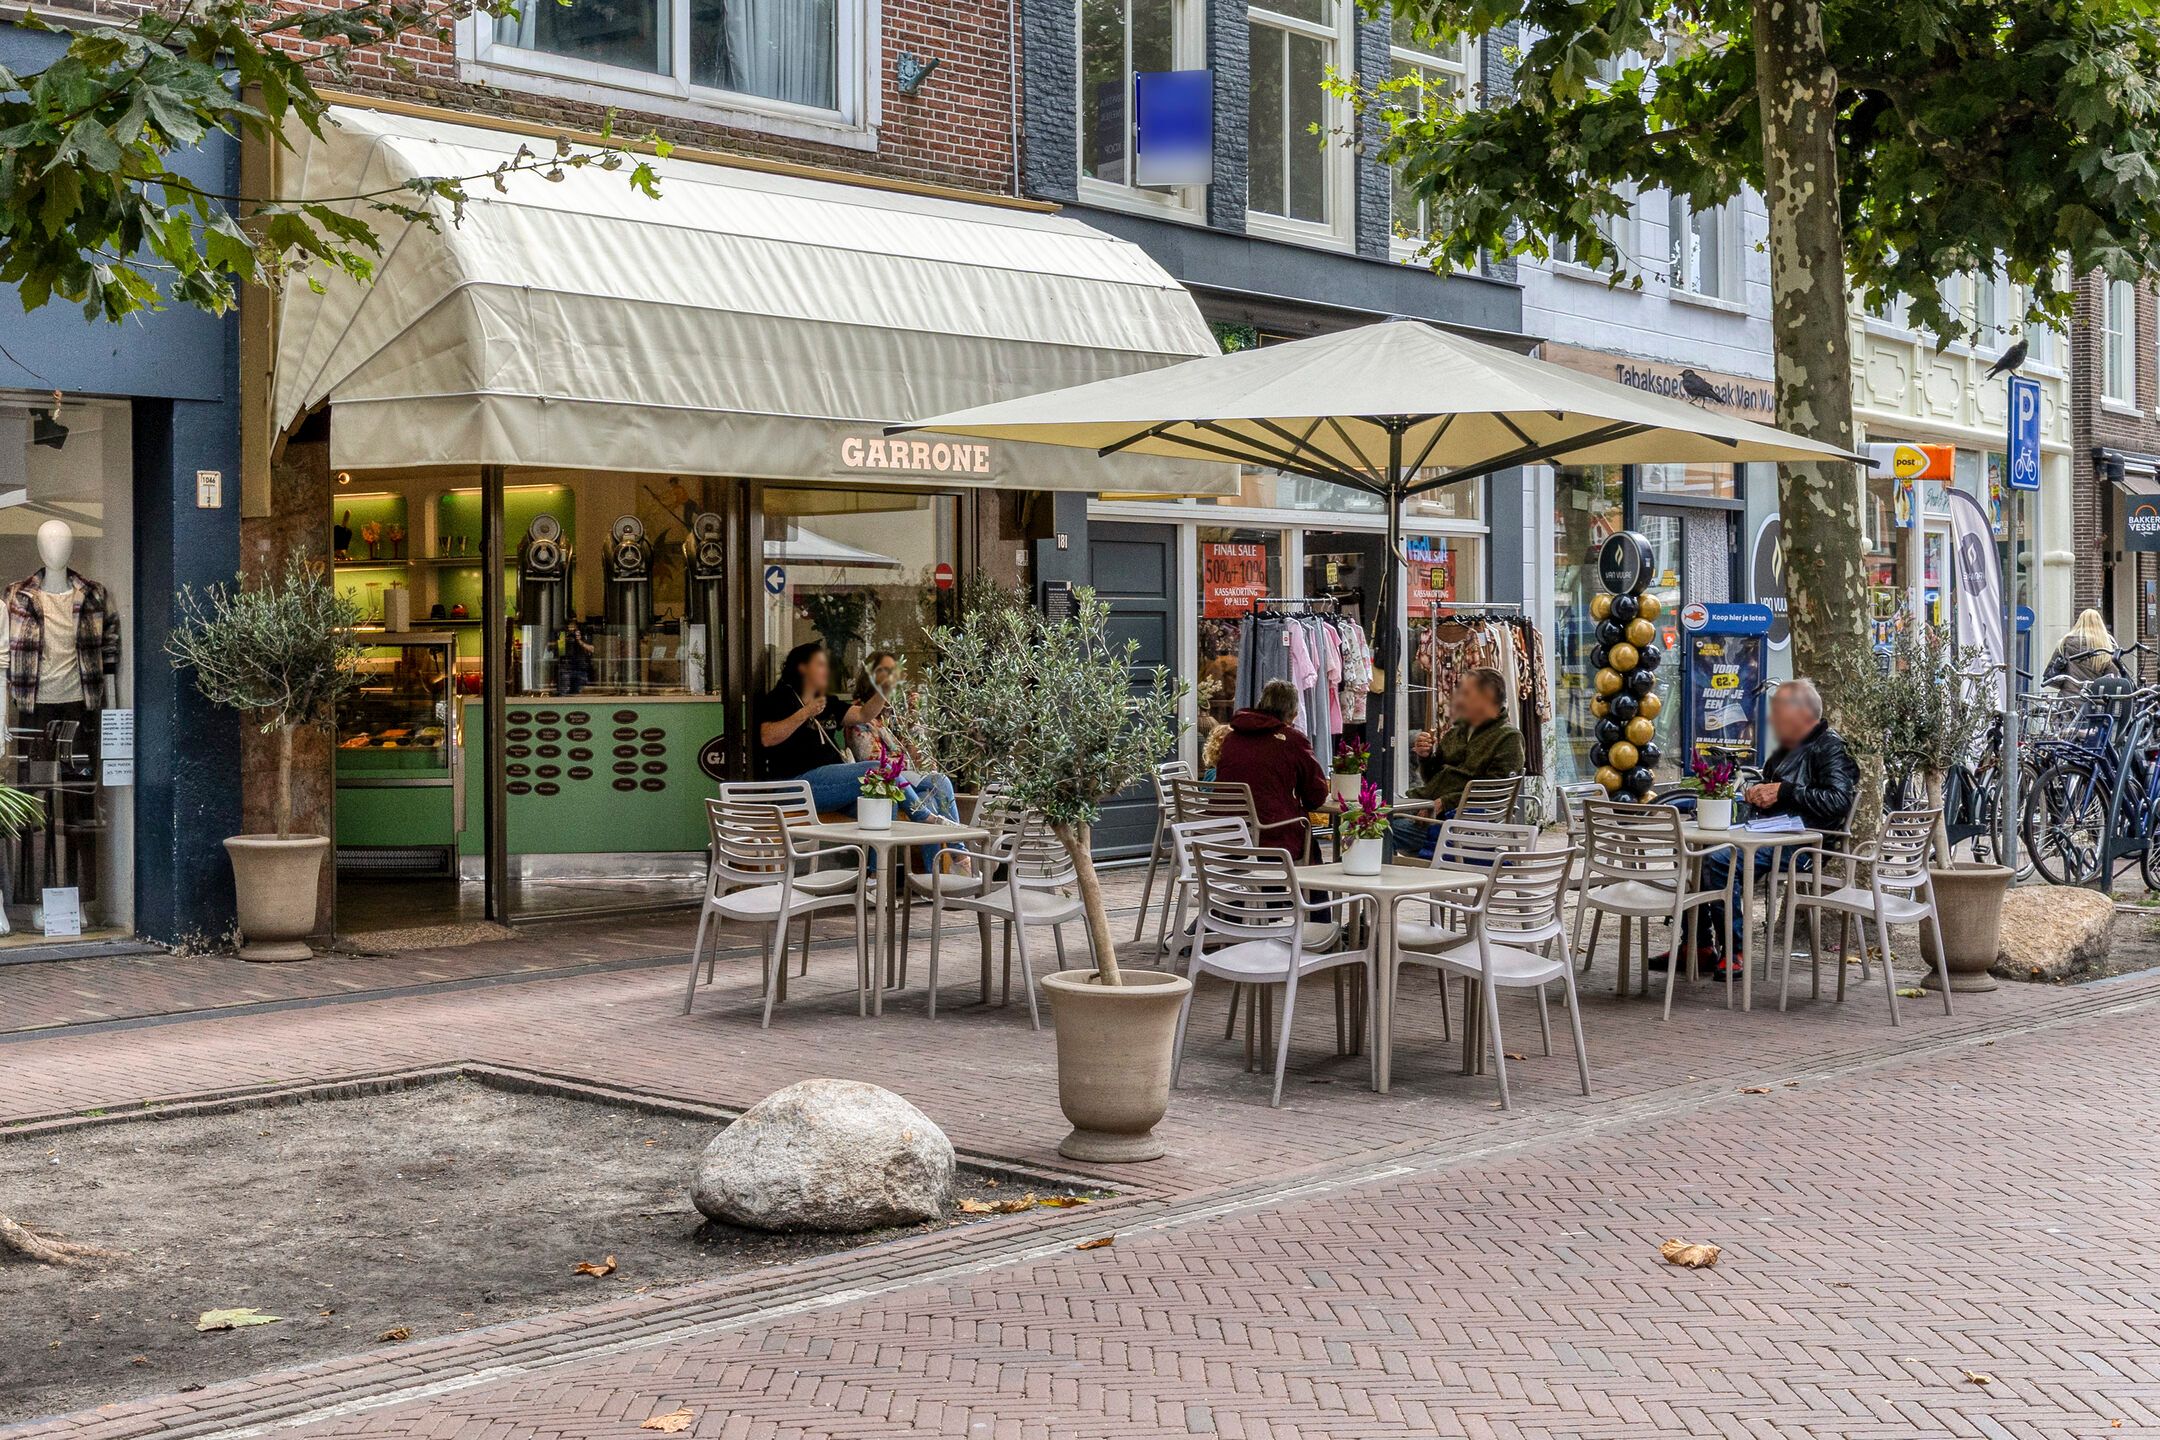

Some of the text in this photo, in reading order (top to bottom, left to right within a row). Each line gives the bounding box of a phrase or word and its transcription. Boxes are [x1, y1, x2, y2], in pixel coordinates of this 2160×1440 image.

[1736, 384, 1756, 409] Van
[1760, 388, 1774, 413] Vu
[2018, 386, 2034, 440] P
[841, 437, 990, 473] GARRONE
[2128, 516, 2160, 524] BAKKER
[1057, 534, 1068, 549] 181
[1213, 544, 1257, 557] FINAL SALE
[1206, 559, 1265, 585] 50%+10%
[1214, 587, 1258, 597] KASSAKORTING
[1224, 597, 1249, 606] OP ALLES
[1712, 614, 1728, 622] Koop
[1712, 664, 1740, 674] VOOR
[1702, 688, 1744, 699] KOOP JE
[1704, 699, 1724, 709] EEN
